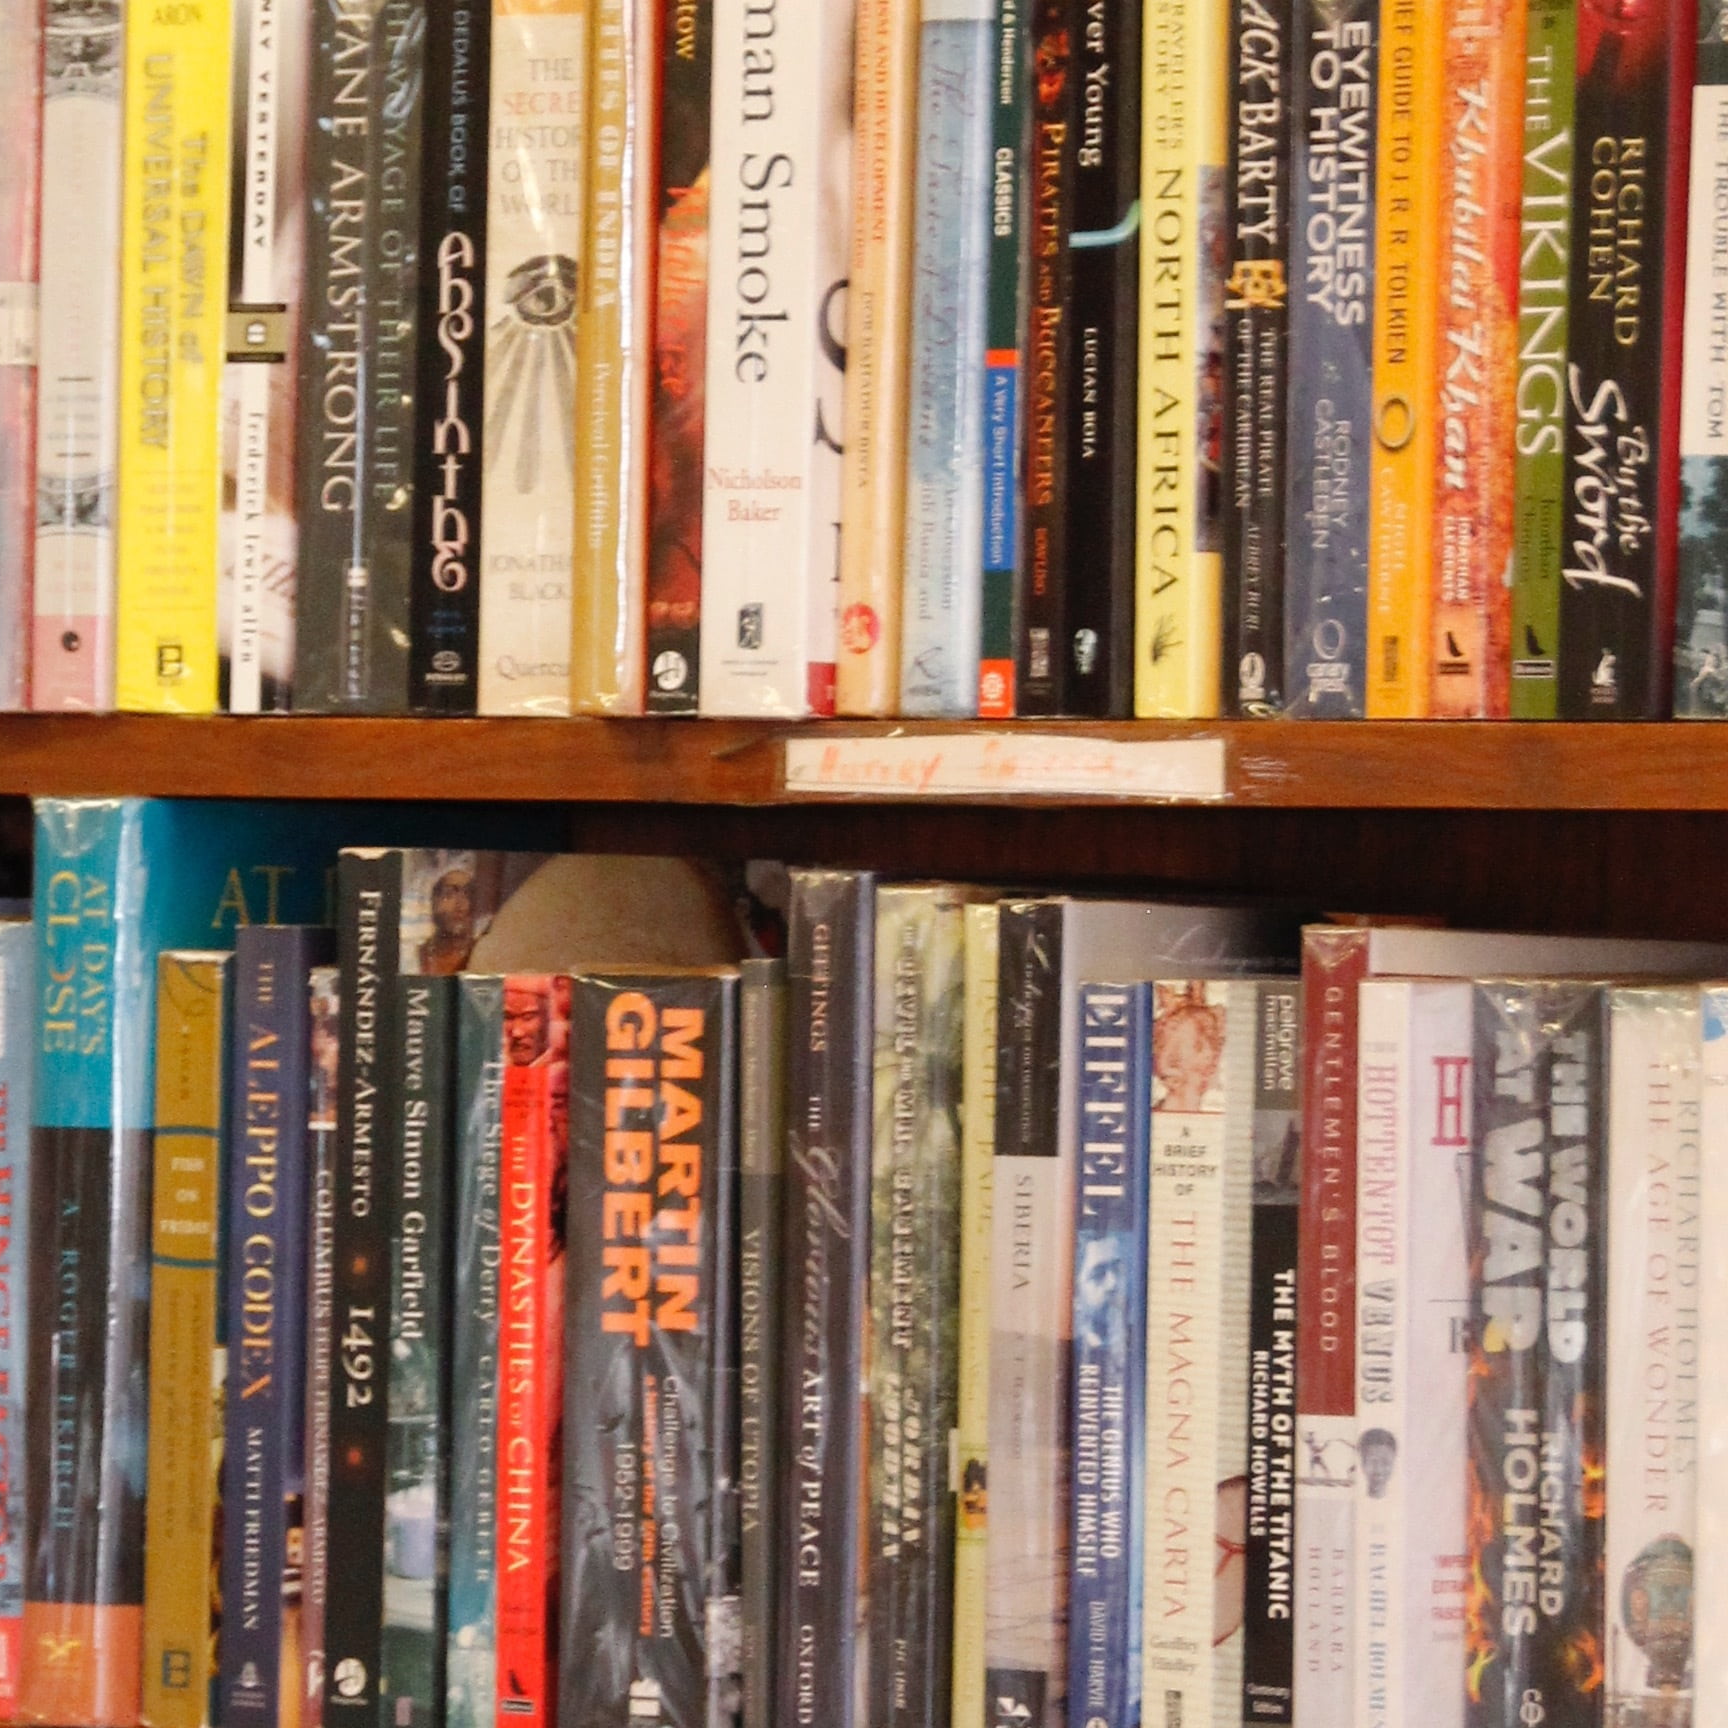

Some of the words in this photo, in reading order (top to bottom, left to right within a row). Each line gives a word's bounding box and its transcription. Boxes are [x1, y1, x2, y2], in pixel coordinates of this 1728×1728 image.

[1311, 19, 1339, 87] TO
[1523, 45, 1555, 130] THE
[1078, 64, 1110, 168] Young
[1235, 100, 1282, 243] BARTY
[1332, 19, 1371, 327] EYEWITNESS
[994, 146, 1013, 237] CLASSICS
[1305, 107, 1339, 314] HISTORY
[1586, 136, 1617, 303] COHEN
[1612, 136, 1647, 347] RICHARD
[734, 152, 796, 384] Smoke
[1151, 165, 1183, 363] NORTH
[1515, 127, 1569, 458] VIKINGS
[706, 468, 804, 494] Nicholson
[726, 499, 780, 523] Baker
[1151, 386, 1183, 597] AFRICA
[1262, 994, 1279, 1091] macmillan
[1272, 994, 1294, 1091] palgrave
[244, 1022, 281, 1218] ALEPPO
[1083, 991, 1127, 1217] EIFFEL
[1321, 986, 1344, 1222] GENTLEMEN'S
[601, 992, 656, 1346] GILBERT
[655, 1006, 706, 1335] MARTIN
[1011, 1175, 1035, 1290] SIBERIA
[1168, 1210, 1197, 1290] THE
[241, 1233, 277, 1401] CODEX
[1266, 1269, 1294, 1321] THE
[1321, 1244, 1344, 1354] BLOOD
[344, 1304, 377, 1408] 1492
[1099, 1384, 1122, 1421] THE
[1165, 1311, 1196, 1470] MAGNA
[1248, 1351, 1269, 1438] RICHARD
[1266, 1329, 1294, 1405] MYTH
[243, 1427, 265, 1504] MATTI
[657, 1375, 681, 1491] Challenge
[1076, 1364, 1099, 1489] REINVENTED
[1099, 1429, 1122, 1501] GENIUS
[1266, 1411, 1294, 1447] OF
[1266, 1454, 1294, 1507] THE
[612, 1440, 637, 1572] 1952-1999
[657, 1495, 681, 1517] to
[1076, 1494, 1099, 1580] HIMSELF
[1099, 1509, 1122, 1559] WHO
[1248, 1444, 1269, 1537] HOWELLS
[1502, 1408, 1538, 1638] HOLMES
[1538, 1431, 1566, 1618] RICHARD
[243, 1510, 265, 1631] FRIEDMAN
[657, 1521, 681, 1639] Civilization
[1161, 1486, 1192, 1619] CARTA
[1266, 1513, 1294, 1619] TITANIC
